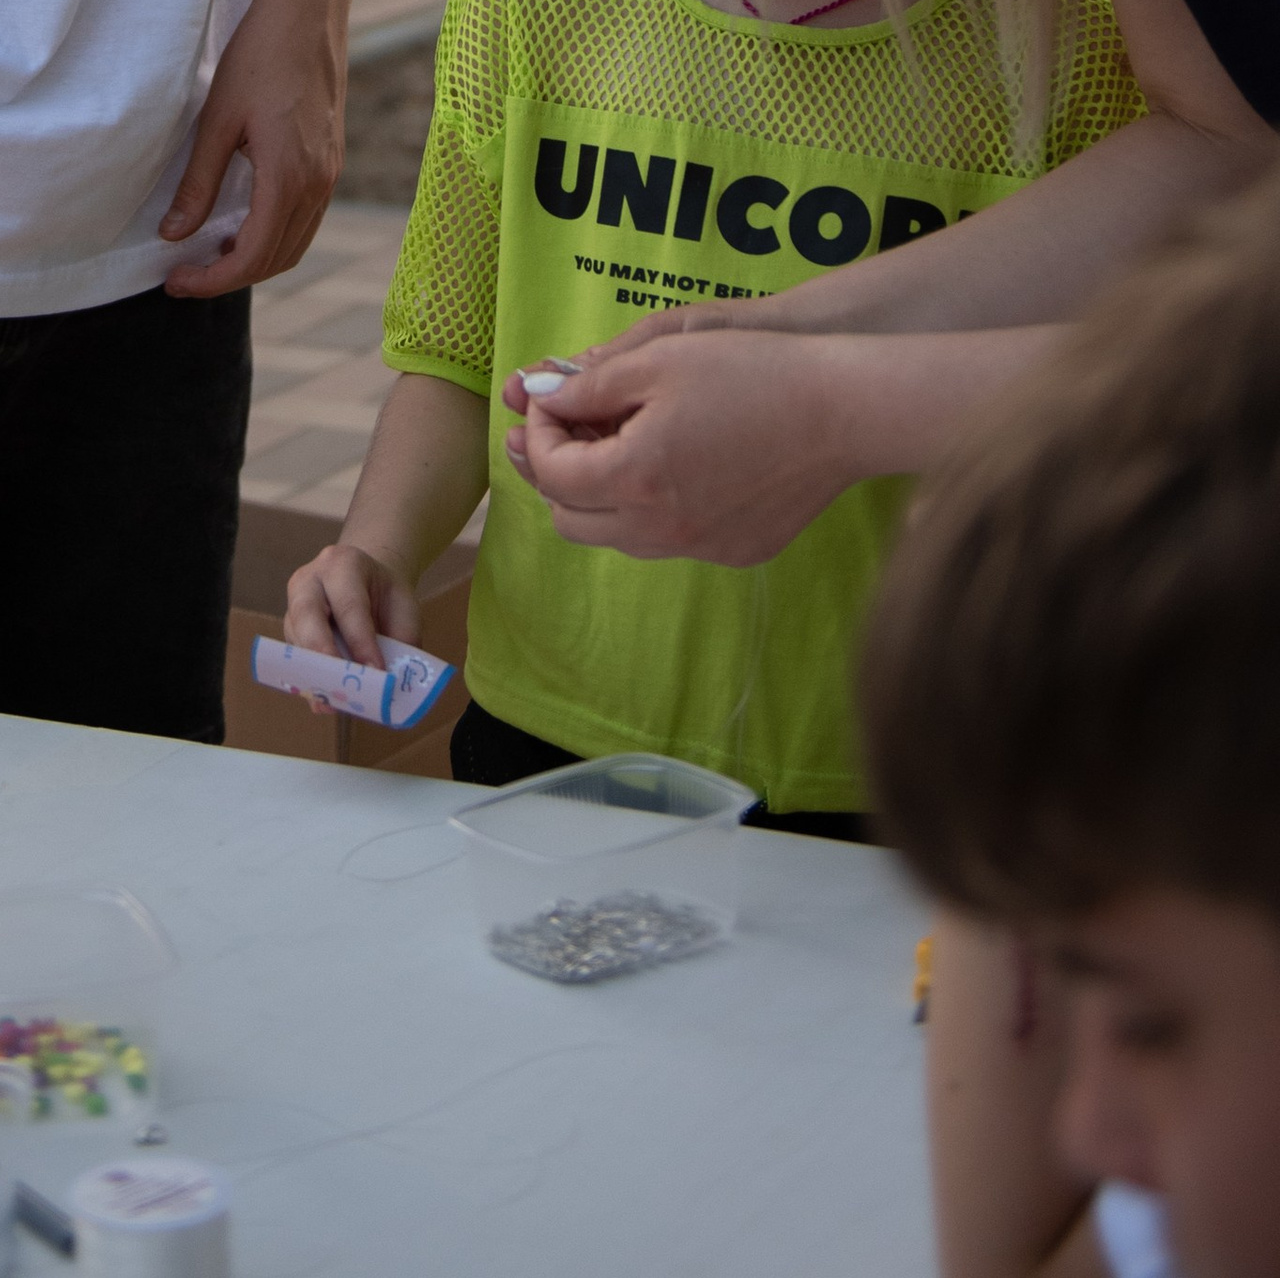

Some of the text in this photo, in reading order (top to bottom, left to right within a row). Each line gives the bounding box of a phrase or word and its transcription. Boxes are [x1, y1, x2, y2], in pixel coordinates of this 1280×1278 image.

[535, 138, 976, 266] UNICOR
[574, 255, 605, 275] YOU
[609, 263, 659, 284] MAY
[662, 272, 710, 294] NOT
[616, 288, 660, 309] BUT
